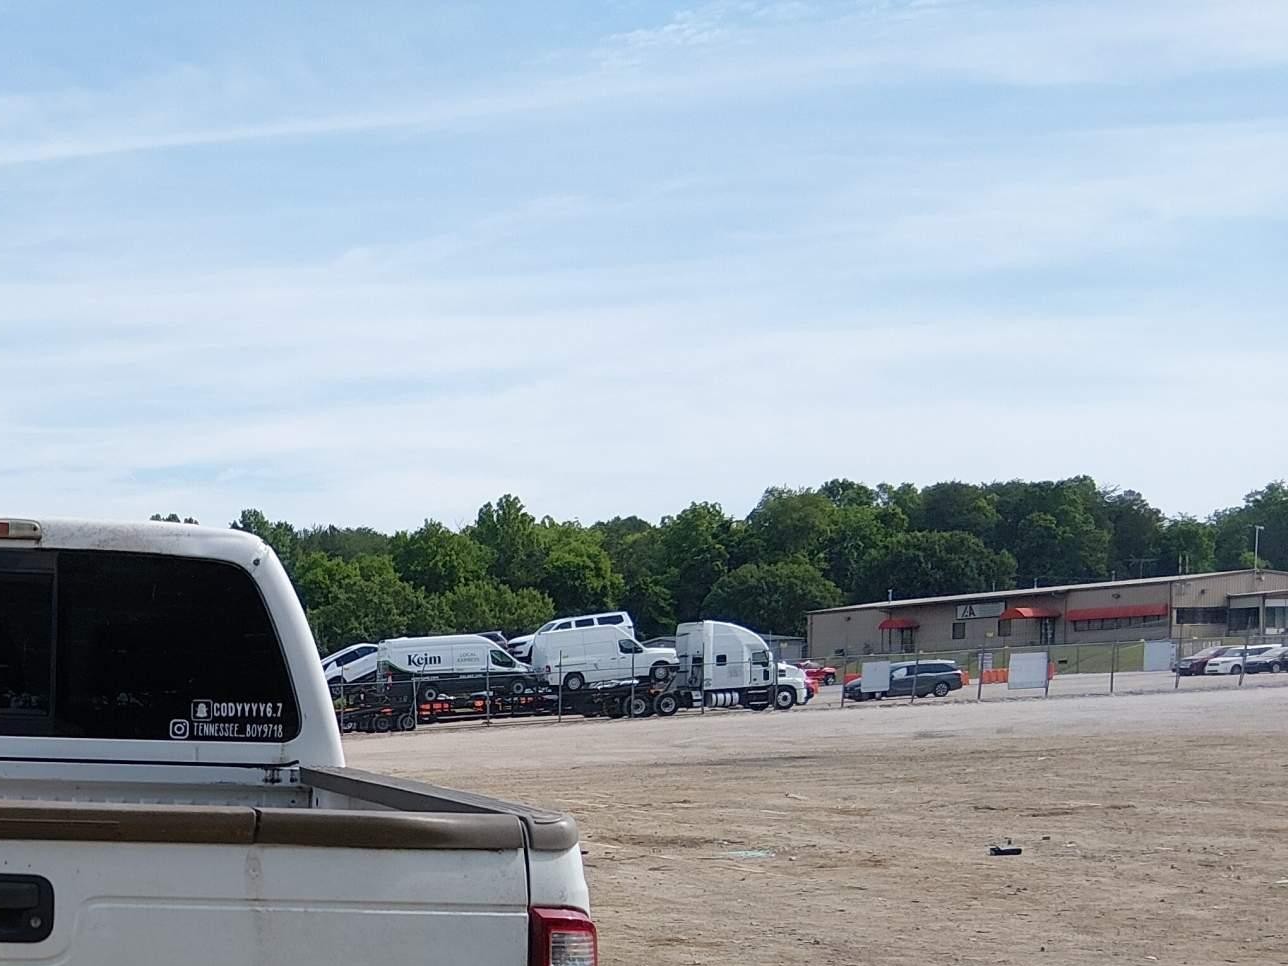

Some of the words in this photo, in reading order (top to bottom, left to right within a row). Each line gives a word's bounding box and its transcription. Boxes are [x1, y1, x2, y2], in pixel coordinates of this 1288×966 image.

[407, 653, 442, 667] Keim
[213, 702, 283, 717] CODYYYY6.7
[193, 722, 283, 738] TENNESSEE_BOY9718
